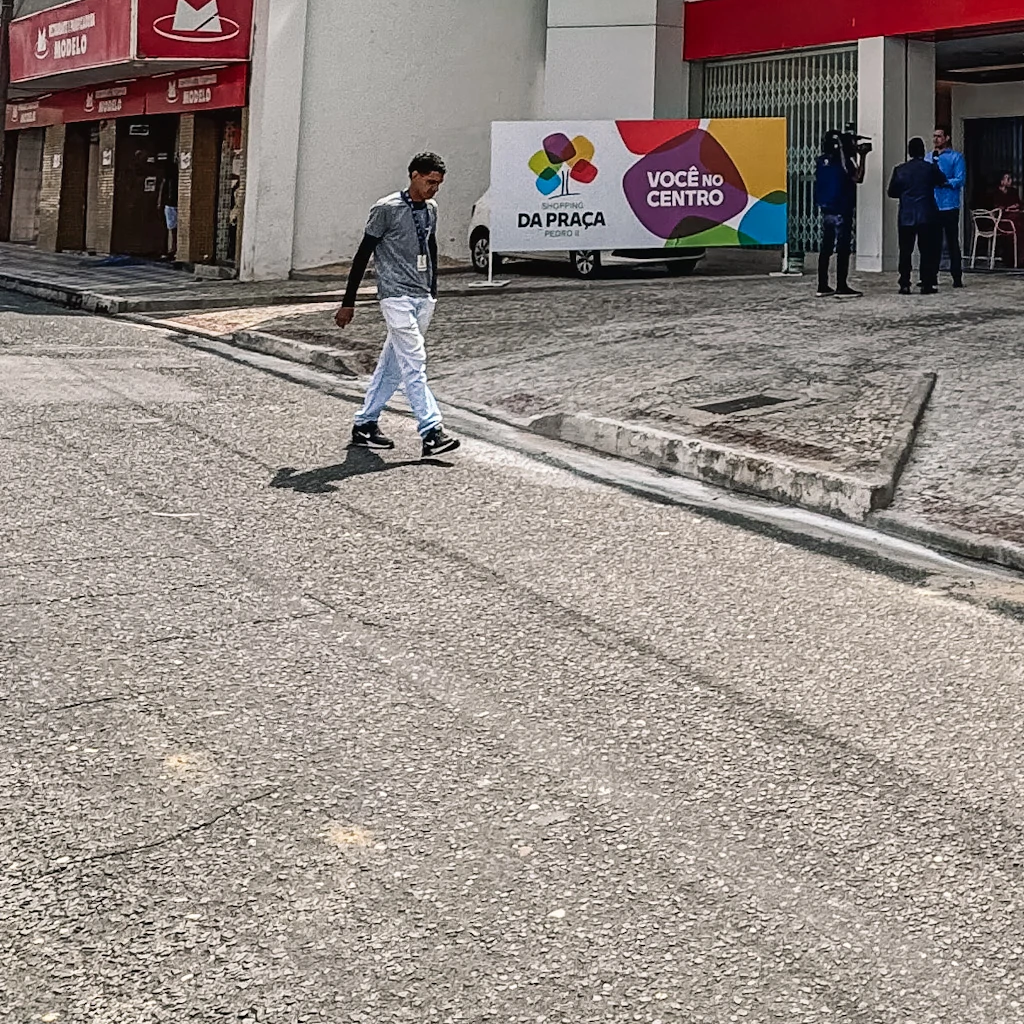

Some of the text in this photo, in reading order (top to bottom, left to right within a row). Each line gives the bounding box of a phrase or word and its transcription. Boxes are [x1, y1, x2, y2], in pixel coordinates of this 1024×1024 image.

[54, 34, 87, 59] MODELO
[182, 88, 212, 105] MODELO
[646, 165, 724, 188] VOCÊ NO
[541, 201, 584, 210] SHOPPING
[646, 189, 724, 207] CENTRO
[518, 212, 606, 230] DA PRAÇA
[544, 229, 573, 237] PEDRO
